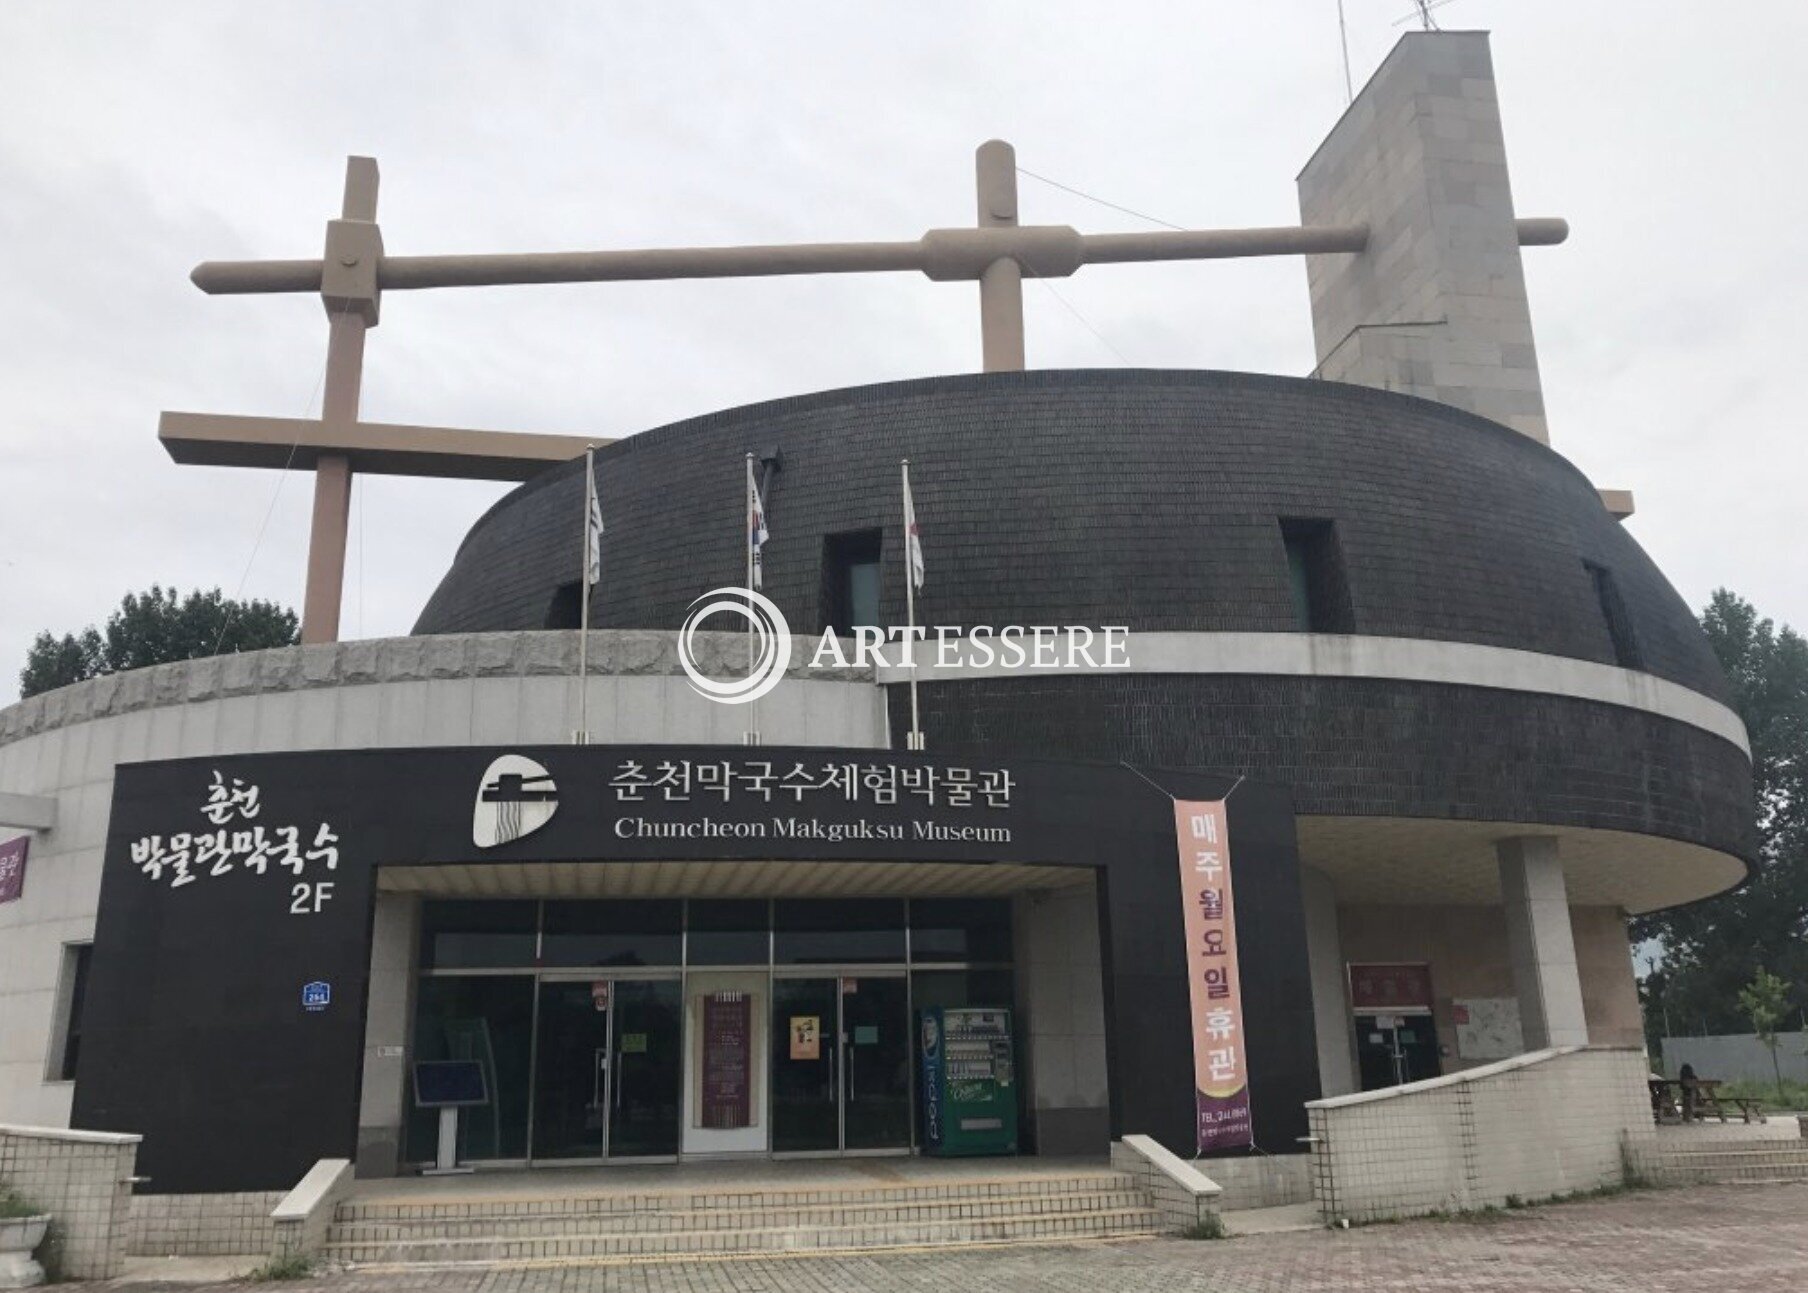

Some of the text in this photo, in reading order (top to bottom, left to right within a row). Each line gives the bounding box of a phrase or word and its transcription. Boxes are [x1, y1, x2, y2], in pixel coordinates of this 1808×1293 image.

[200, 769, 261, 825] 춘천
[608, 760, 1016, 808] 춘천막국수체험박물관
[614, 817, 1012, 843] Chuncheon Makguksu Museum
[289, 882, 336, 914] 2F
